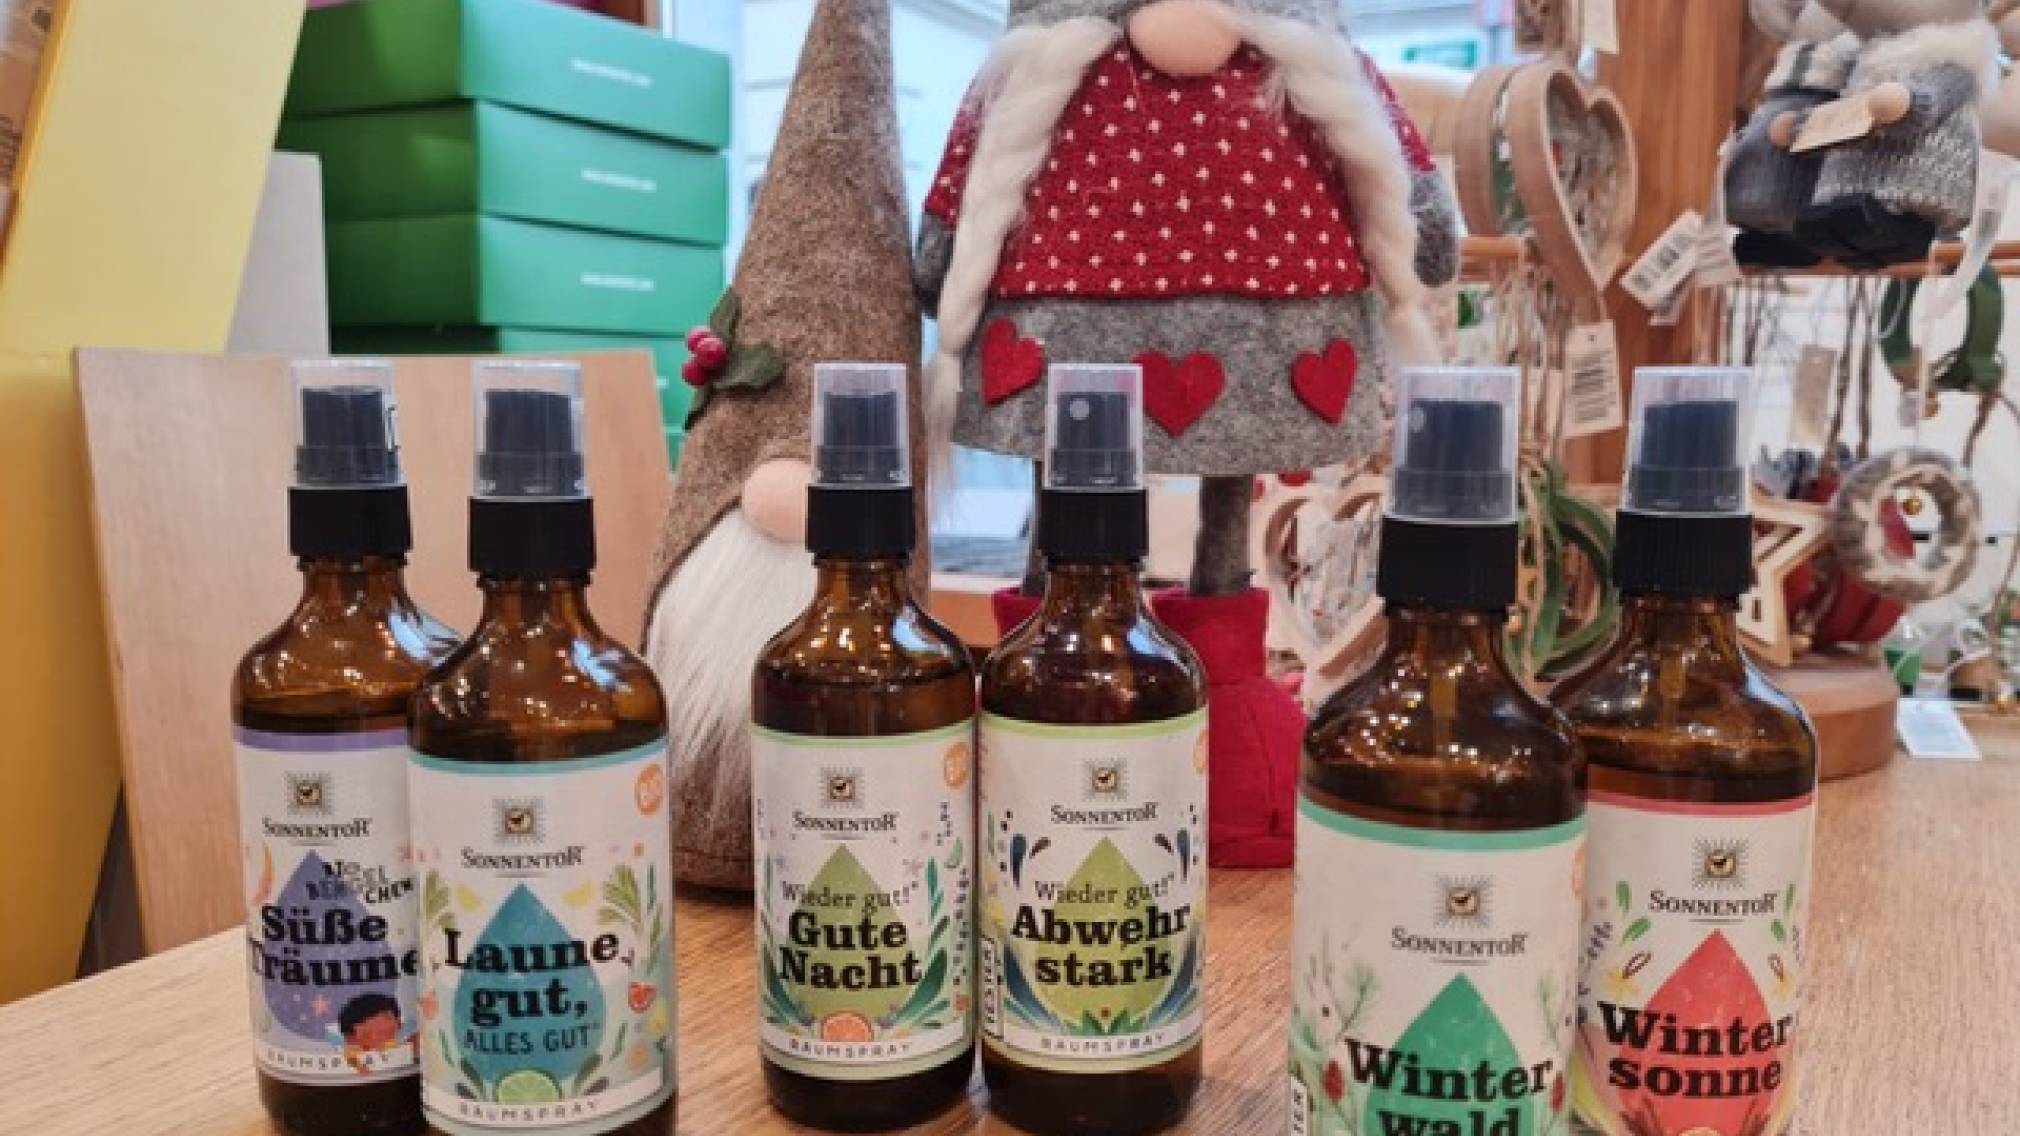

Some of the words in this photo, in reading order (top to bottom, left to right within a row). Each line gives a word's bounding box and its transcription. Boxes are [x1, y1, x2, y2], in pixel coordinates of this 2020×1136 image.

[1034, 880, 1118, 904] Wieder
[262, 906, 388, 945] Süße
[788, 911, 907, 950] Gute
[1011, 905, 1190, 947] Abwehr
[780, 946, 923, 991] Nacht
[1035, 946, 1172, 987] stark
[471, 979, 588, 1027] gut,
[464, 1029, 534, 1055] ALLES
[789, 1037, 913, 1058] RAUMSPRAY
[1040, 1034, 1166, 1053] RAUMSPRAY
[1596, 1000, 1793, 1060] Winter
[1345, 1038, 1553, 1104] Winter
[1608, 1052, 1782, 1100] sonne
[457, 1099, 596, 1121] RAUMSPRAY
